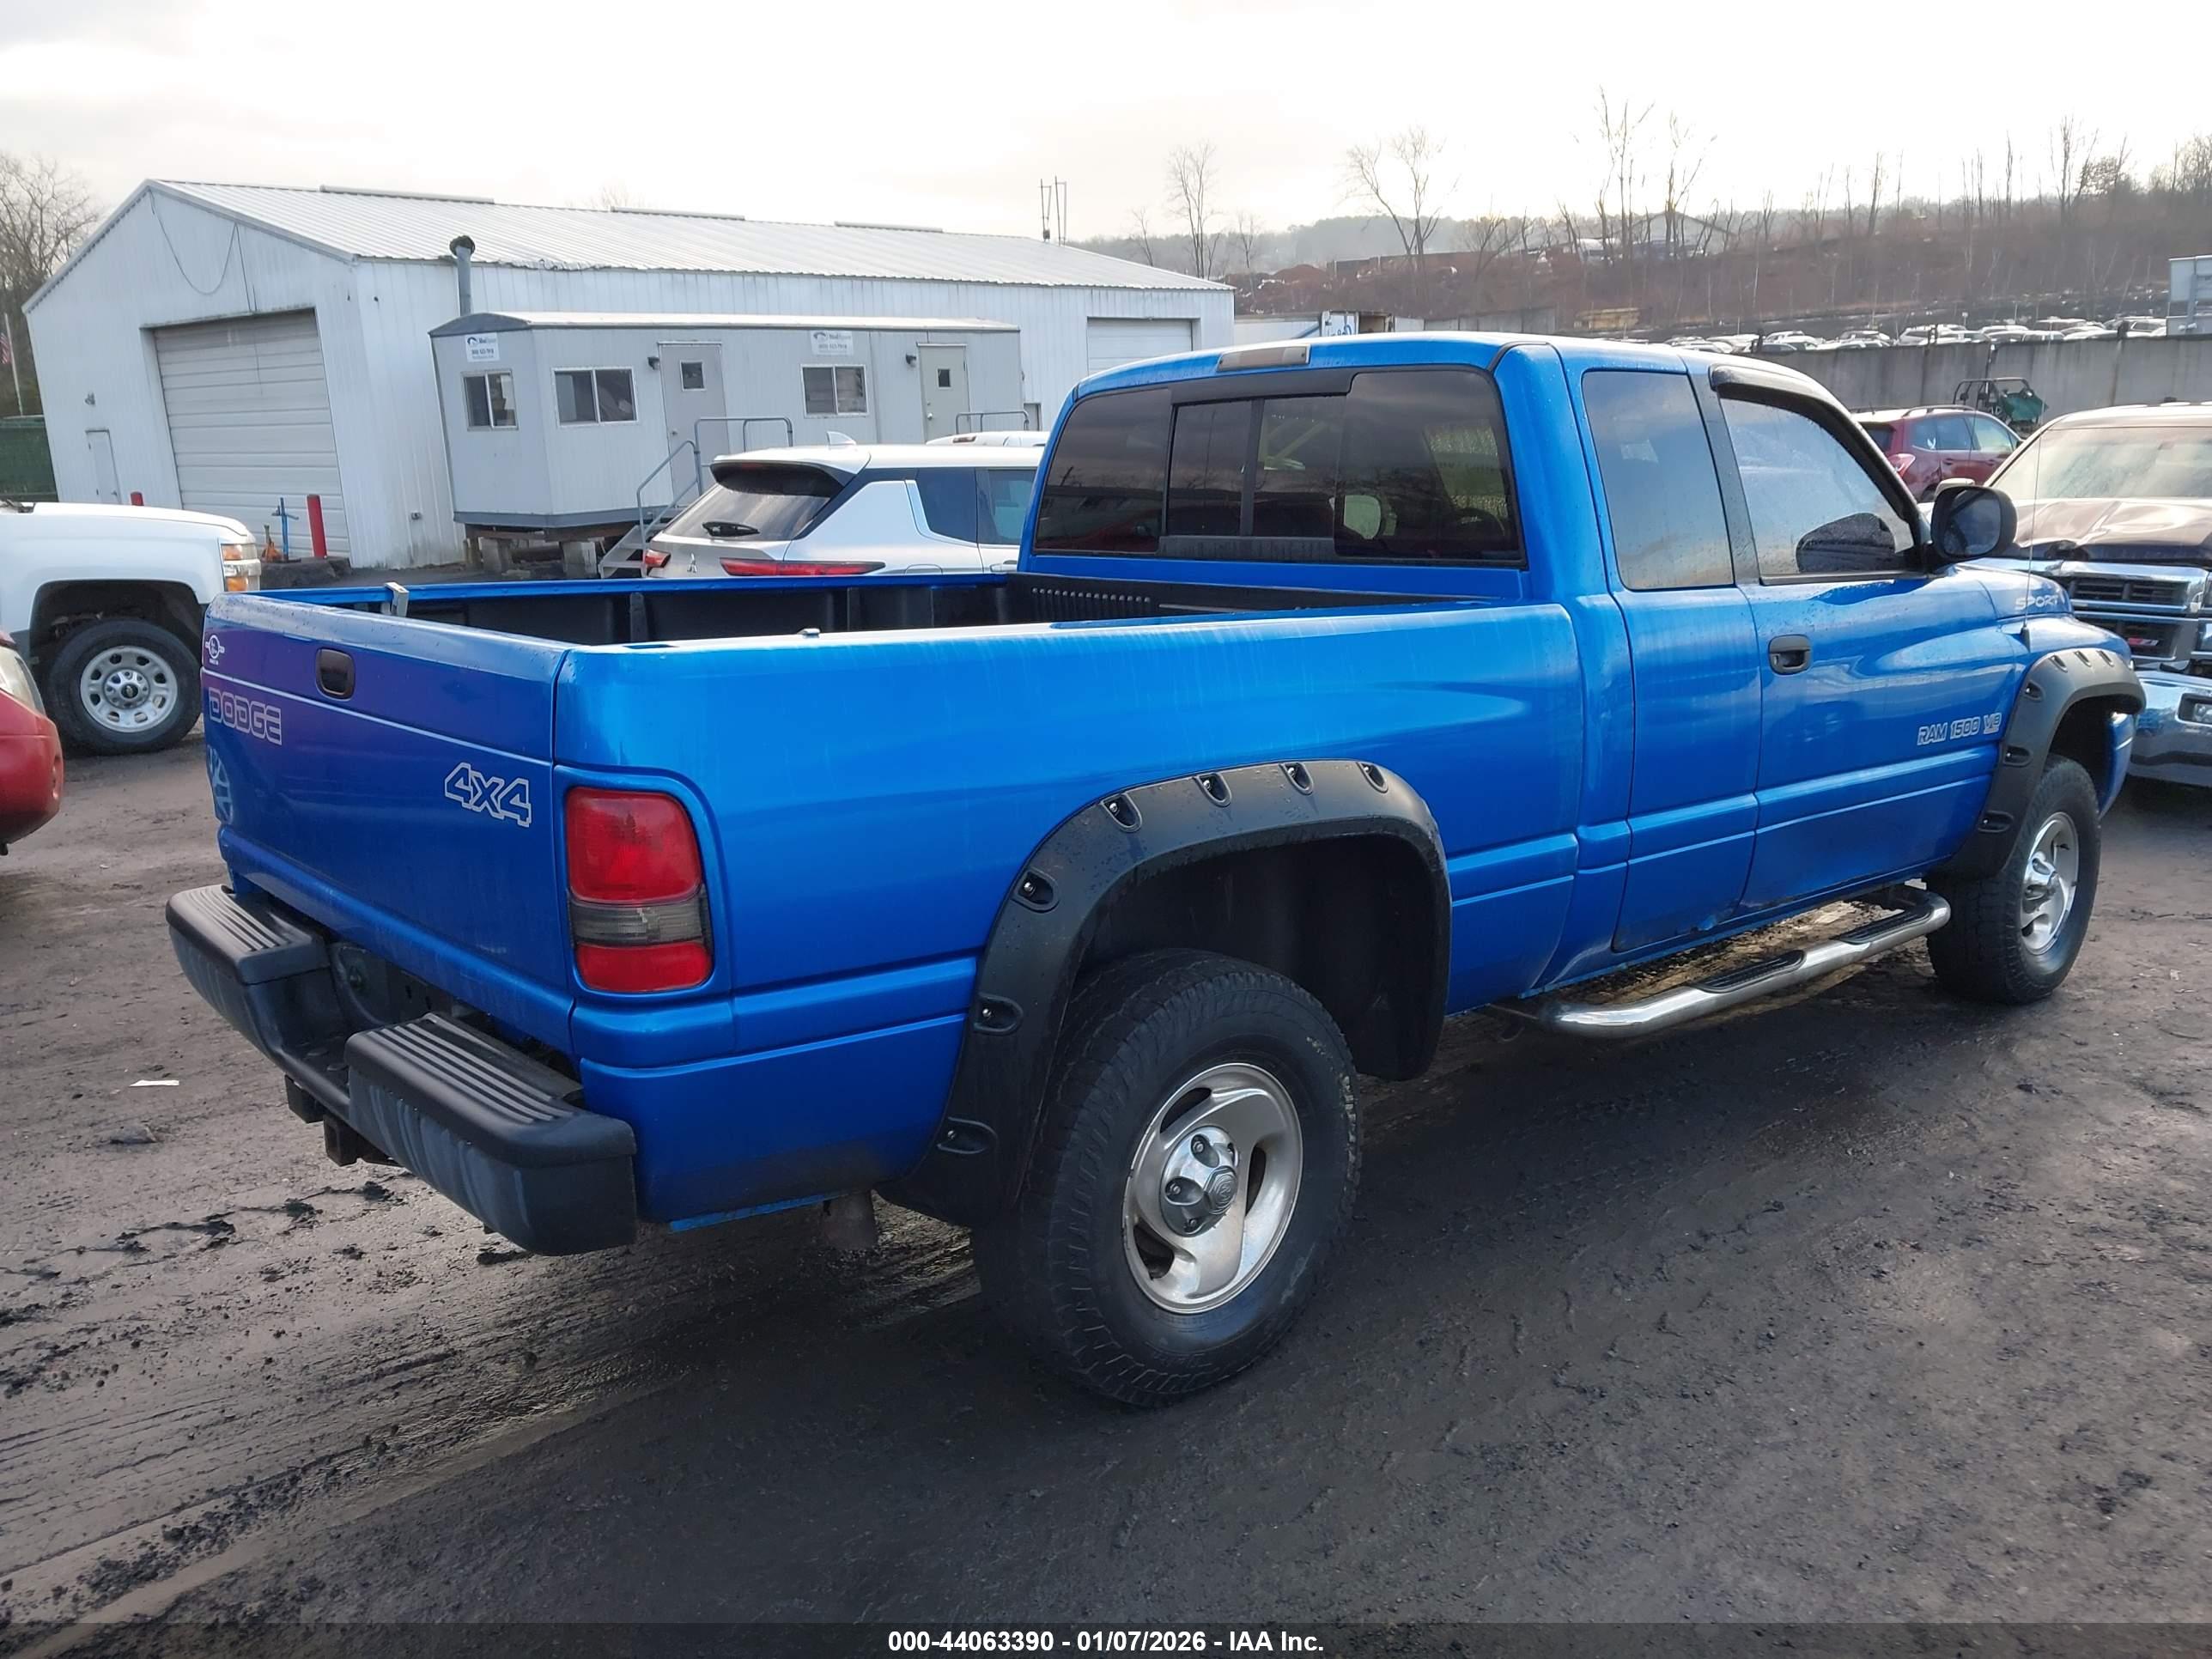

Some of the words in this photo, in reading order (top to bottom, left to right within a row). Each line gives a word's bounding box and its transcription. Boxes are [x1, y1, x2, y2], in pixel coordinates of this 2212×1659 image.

[2014, 594, 2058, 611] SPORT
[209, 686, 283, 745] DODGE
[1917, 722, 1948, 746] RAM
[1949, 716, 1981, 740] 1500
